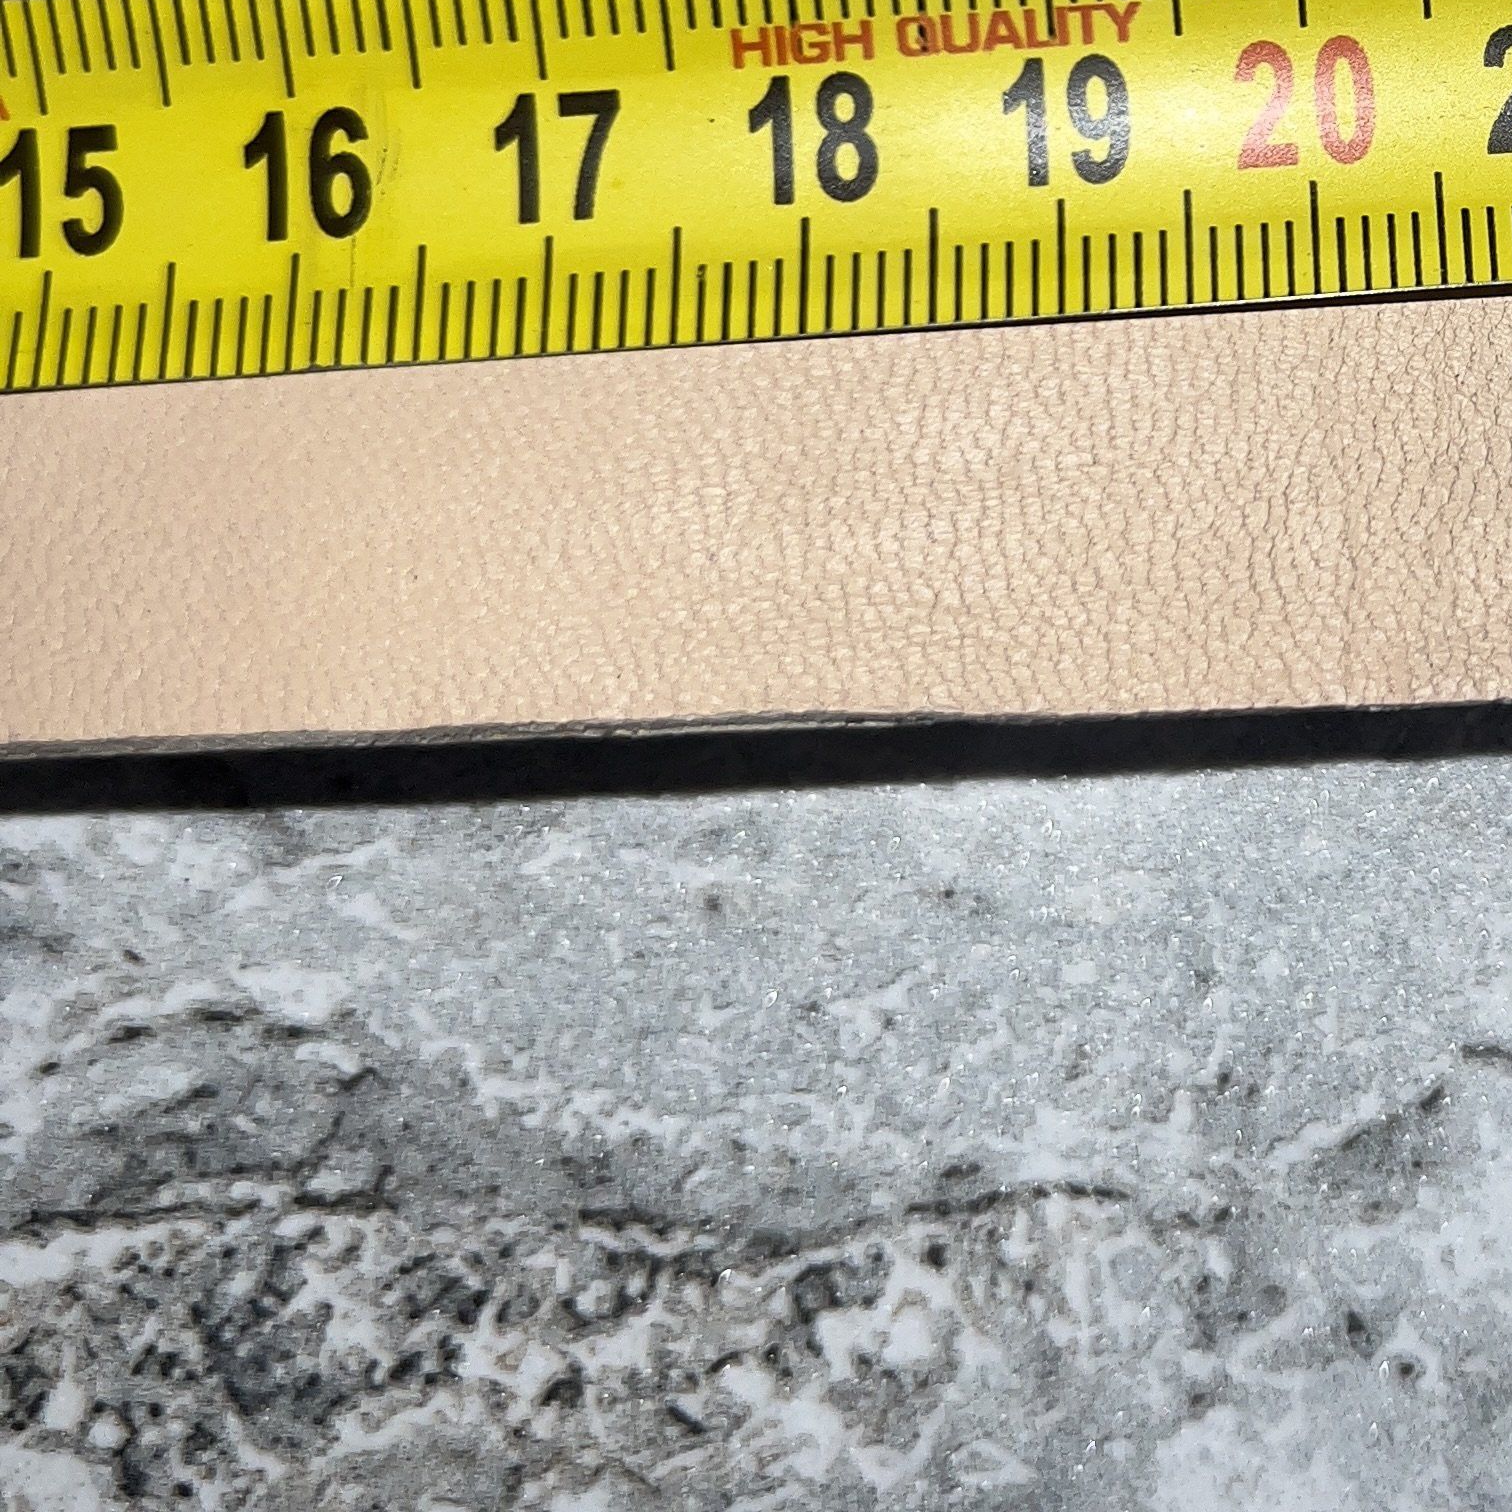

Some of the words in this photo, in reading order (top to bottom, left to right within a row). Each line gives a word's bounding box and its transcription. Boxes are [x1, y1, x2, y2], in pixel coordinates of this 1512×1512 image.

[730, 19, 875, 69] HIGH
[899, 1, 1142, 57] QUALITY
[0, 124, 124, 259] 15
[243, 106, 373, 242] 16
[494, 89, 621, 225] 17
[748, 71, 879, 206] 18
[1002, 53, 1131, 187] 19
[1234, 35, 1376, 170] 20
